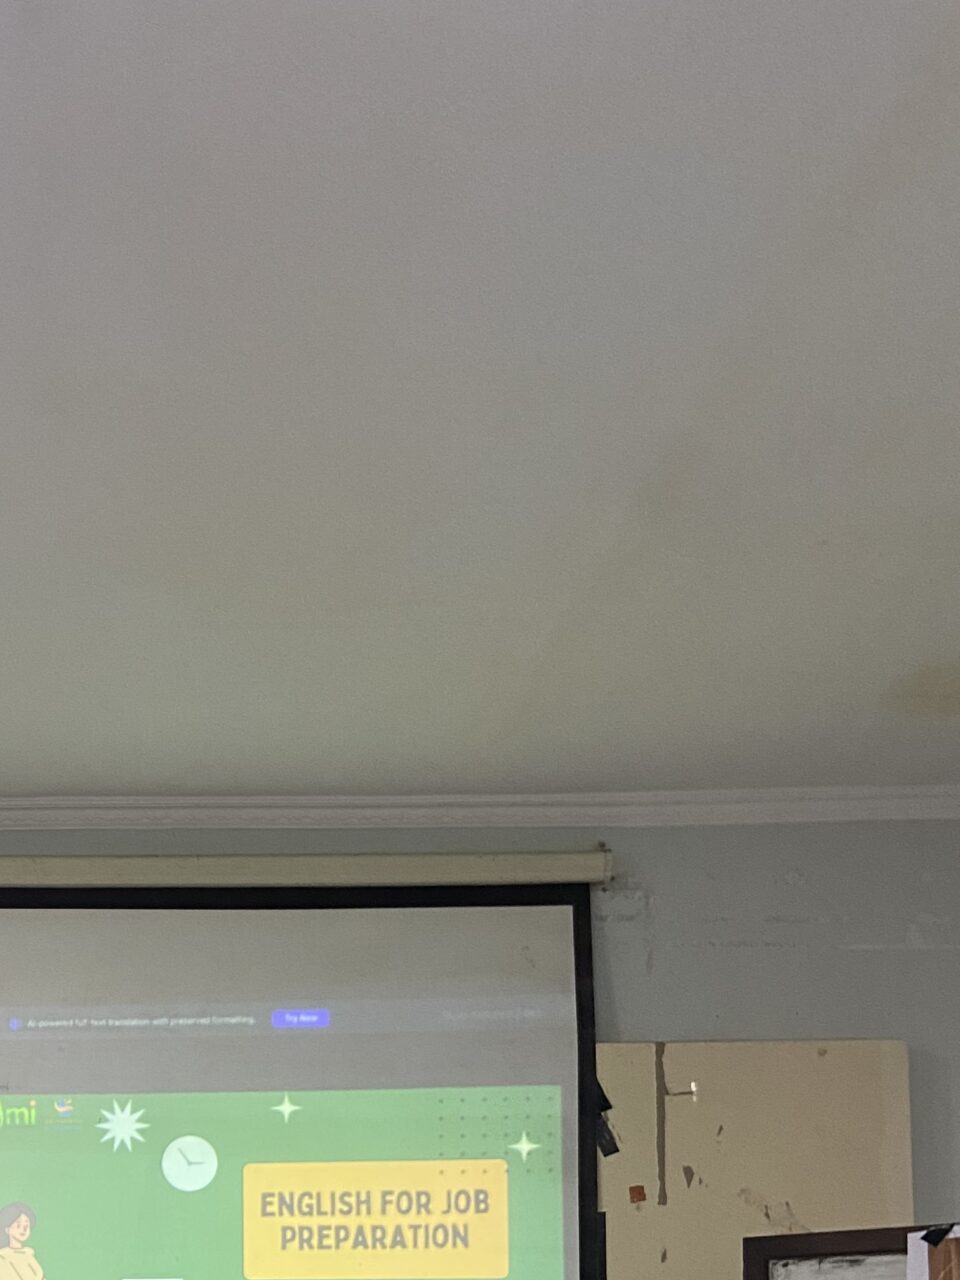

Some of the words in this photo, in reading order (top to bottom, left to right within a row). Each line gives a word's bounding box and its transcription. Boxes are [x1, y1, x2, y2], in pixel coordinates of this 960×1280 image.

[260, 1190, 373, 1217] ENGLISH
[380, 1189, 432, 1216] FOR
[441, 1188, 490, 1215] JOB
[280, 1223, 470, 1251] PREPARATION
